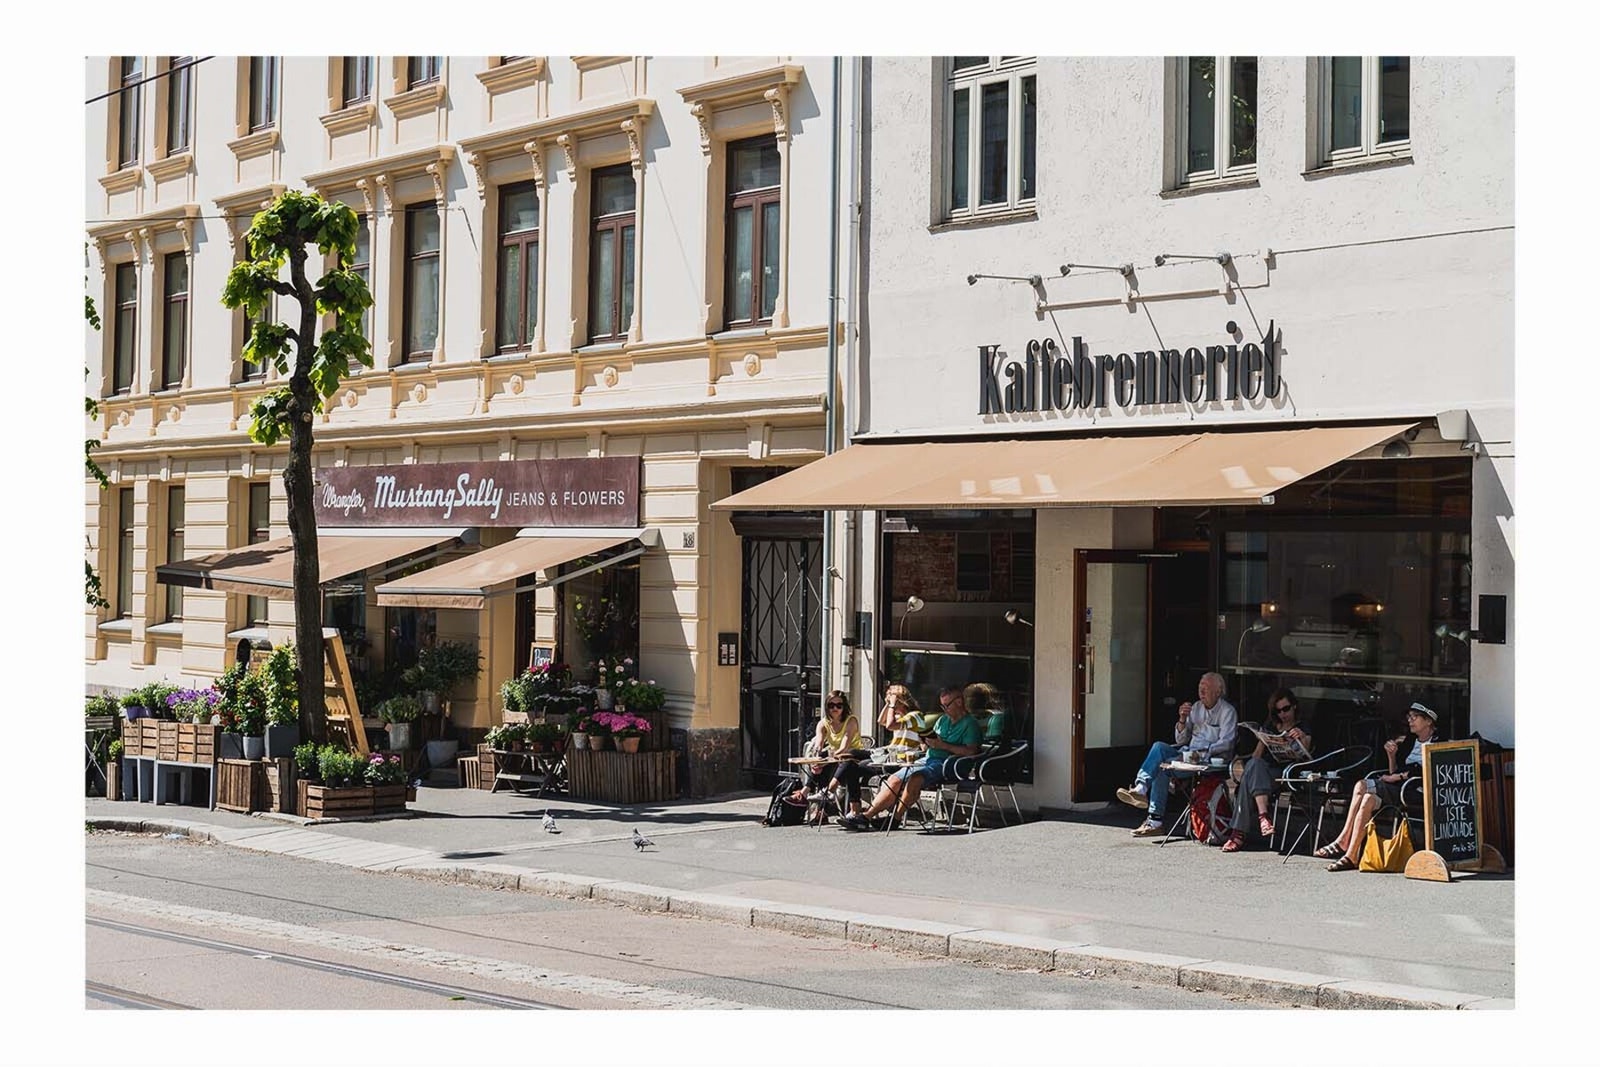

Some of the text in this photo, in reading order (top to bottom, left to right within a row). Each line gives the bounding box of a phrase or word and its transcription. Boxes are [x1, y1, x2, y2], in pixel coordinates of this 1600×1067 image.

[977, 320, 1281, 415] Kaffebrenneriet
[322, 482, 364, 517] Wrangler
[506, 492, 545, 506] JEANS
[550, 492, 558, 505] &
[563, 490, 625, 505] FLOWERS
[1435, 764, 1475, 786] ISKAFFE
[1435, 787, 1475, 807] ISMOCCA
[1446, 806, 1467, 822] ISTE
[1433, 821, 1474, 841] LIMONADE
